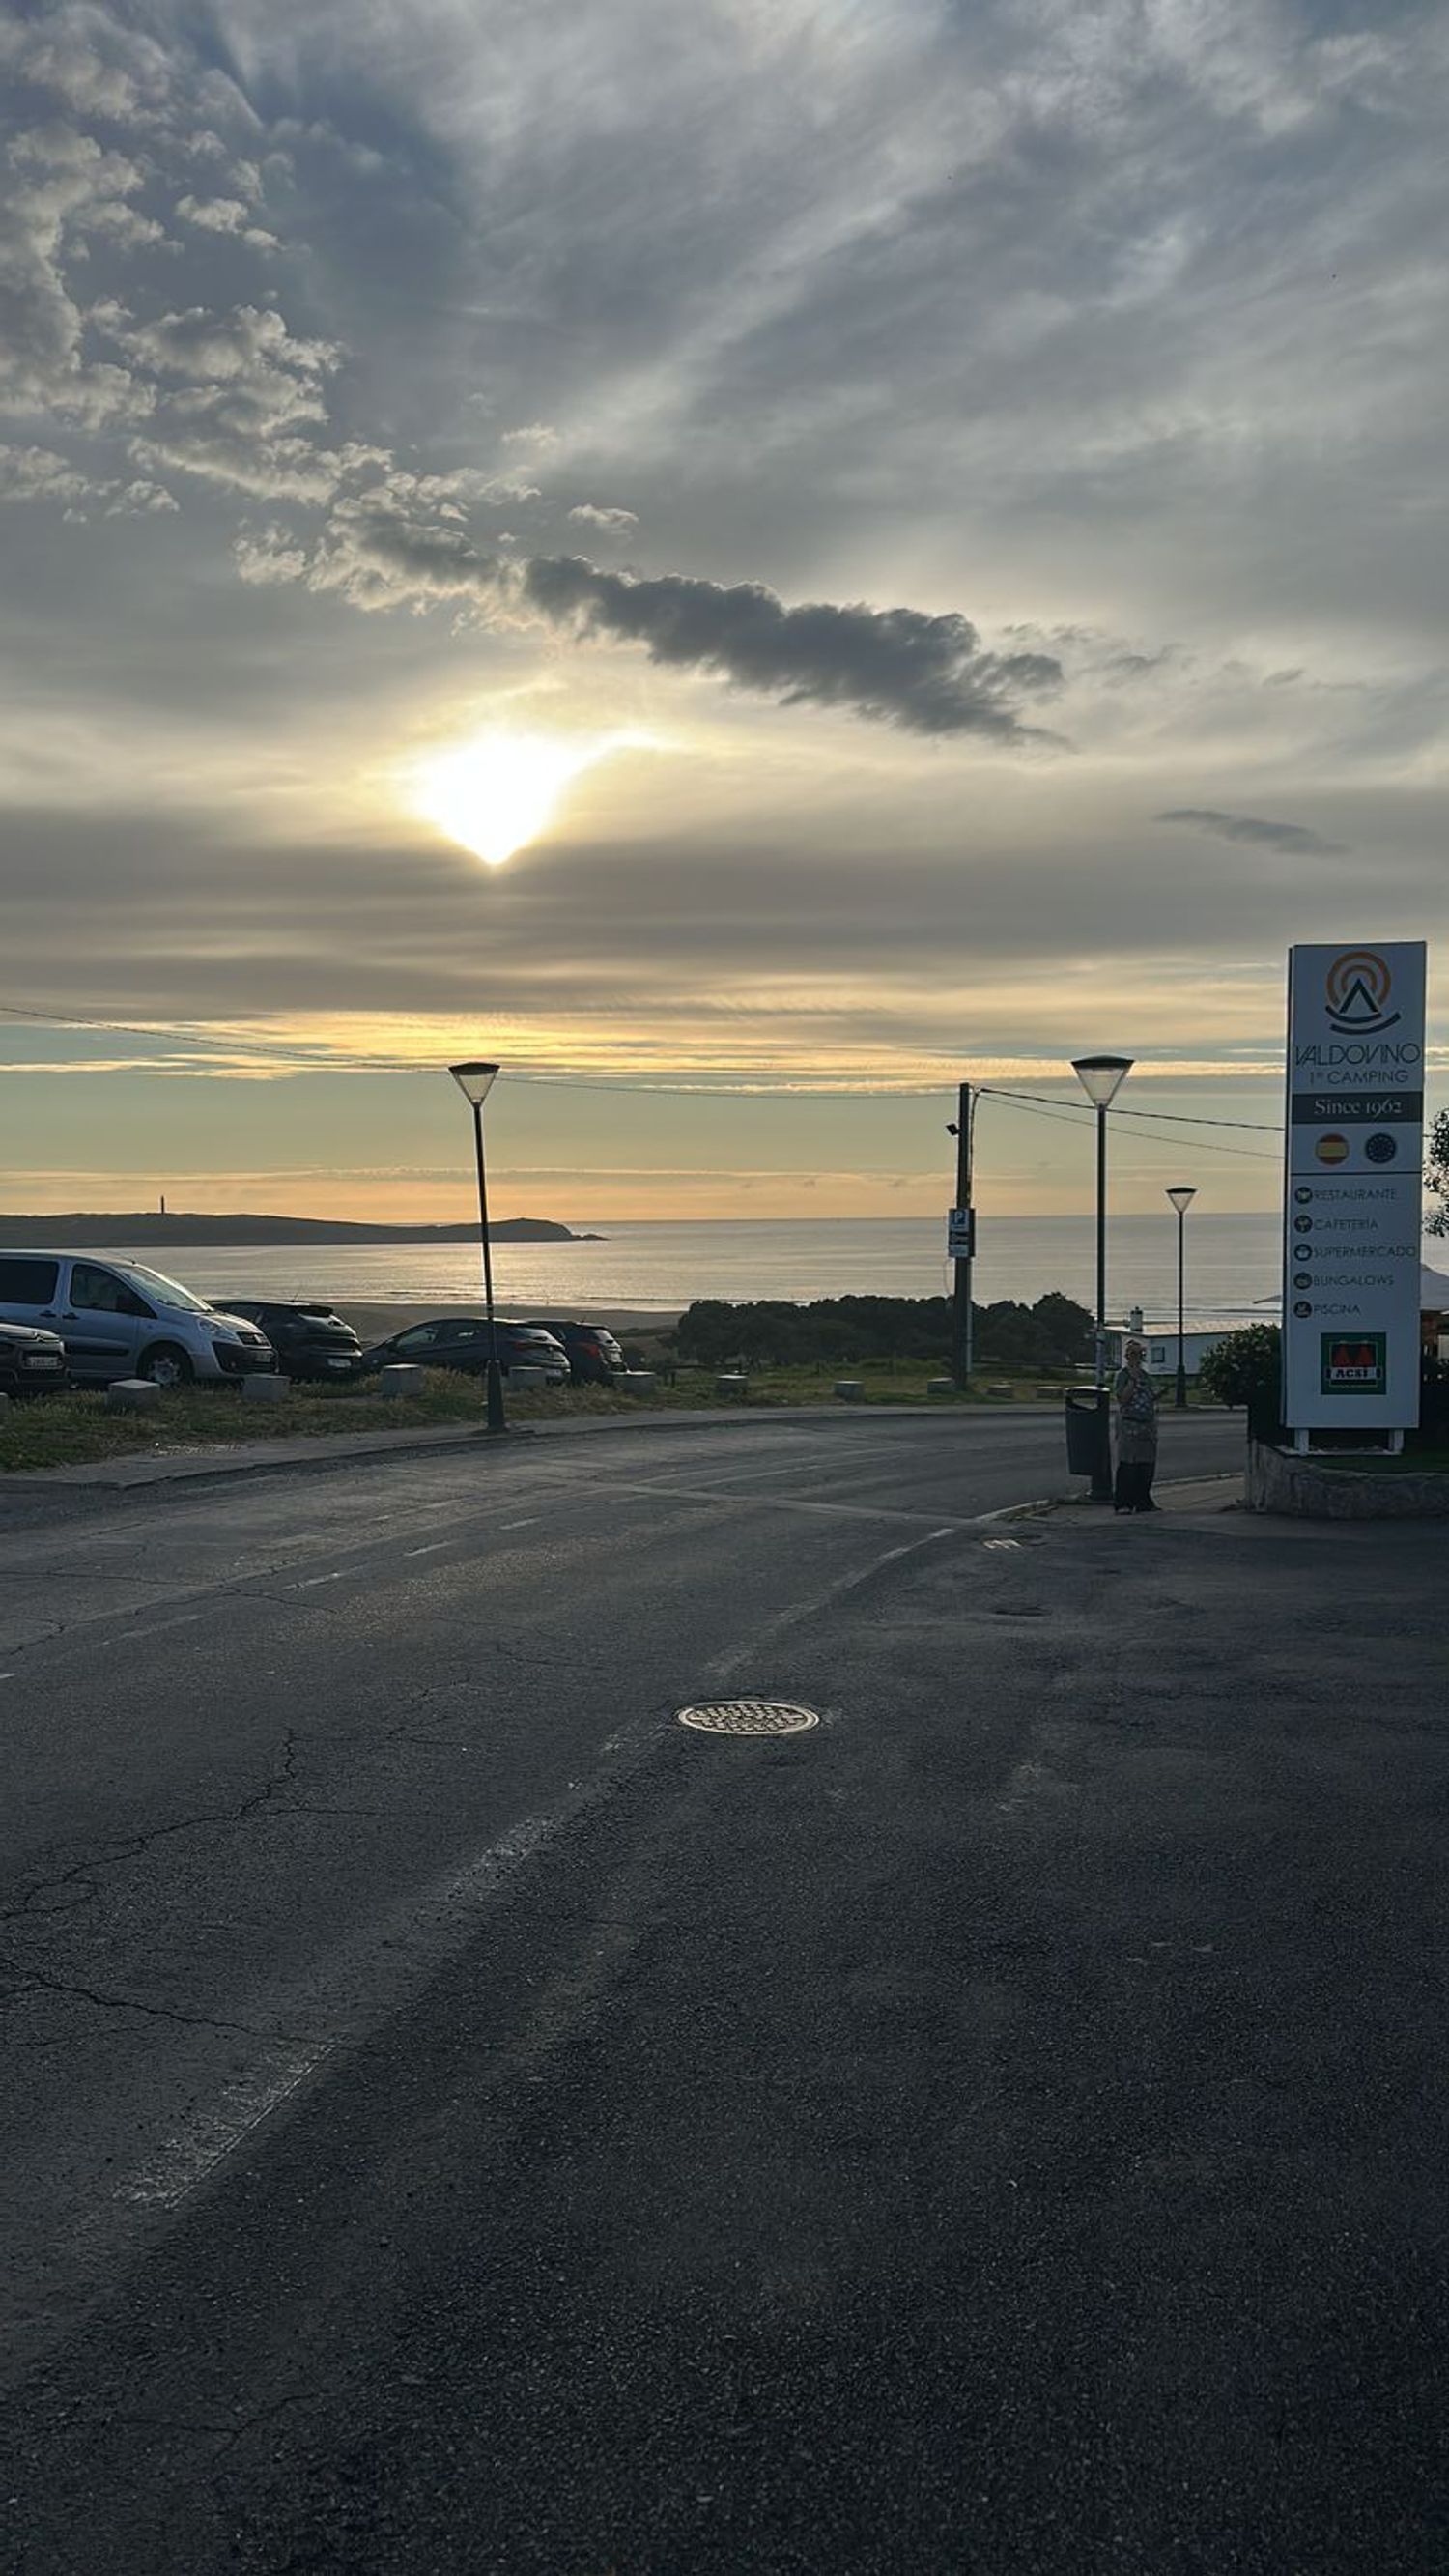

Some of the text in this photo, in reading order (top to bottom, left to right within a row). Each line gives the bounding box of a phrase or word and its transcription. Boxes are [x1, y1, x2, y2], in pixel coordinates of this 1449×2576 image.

[1327, 1070, 1409, 1084] CAMPING
[1314, 1098, 1403, 1117] Since 1962
[1314, 1188, 1396, 1200] RESTAURANTE
[954, 1211, 963, 1223] P
[1315, 1246, 1416, 1258] SUPERMERCADO
[1315, 1275, 1394, 1286] BUNGALOWS
[1314, 1304, 1361, 1315] PISCINA
